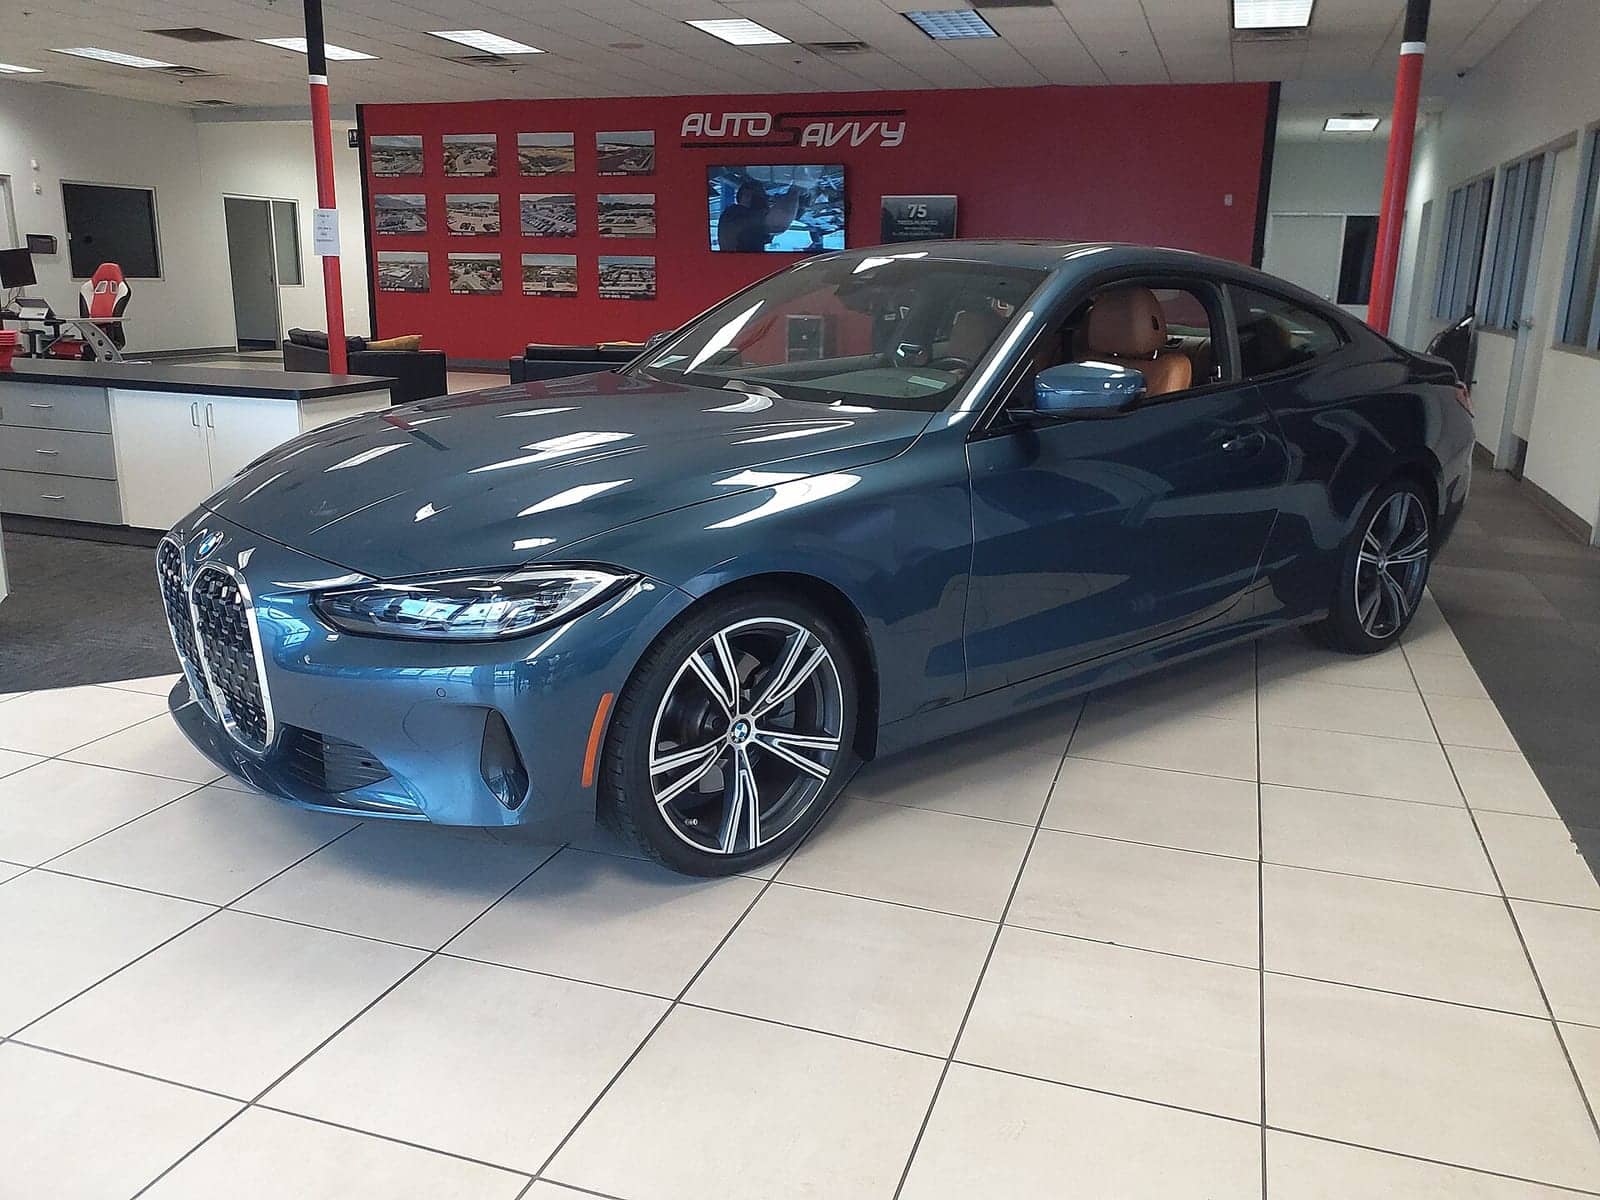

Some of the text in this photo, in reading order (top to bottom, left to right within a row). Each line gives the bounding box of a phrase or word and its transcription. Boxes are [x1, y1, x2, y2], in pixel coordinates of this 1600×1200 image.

[681, 110, 906, 148] AUTO SAVVY
[907, 203, 928, 218] 75
